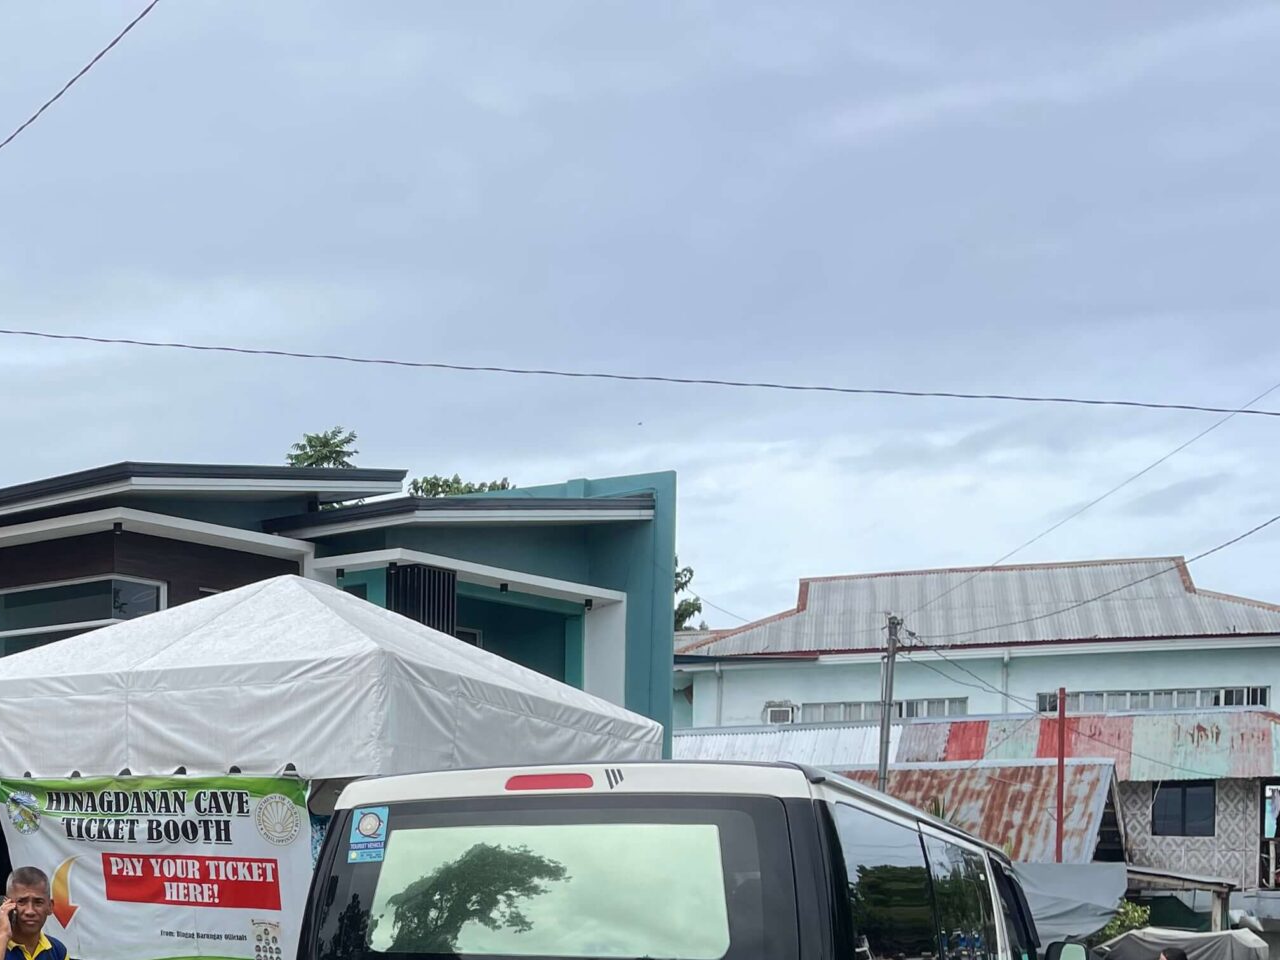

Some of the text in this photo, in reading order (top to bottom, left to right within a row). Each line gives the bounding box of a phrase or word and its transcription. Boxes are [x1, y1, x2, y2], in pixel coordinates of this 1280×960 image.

[45, 790, 187, 815] HINAGDANAN
[194, 790, 251, 816] CAVE
[62, 817, 232, 845] TICKET BOOTH
[109, 857, 276, 882] PAY YOUR TICKET
[164, 881, 220, 904] HERE!
